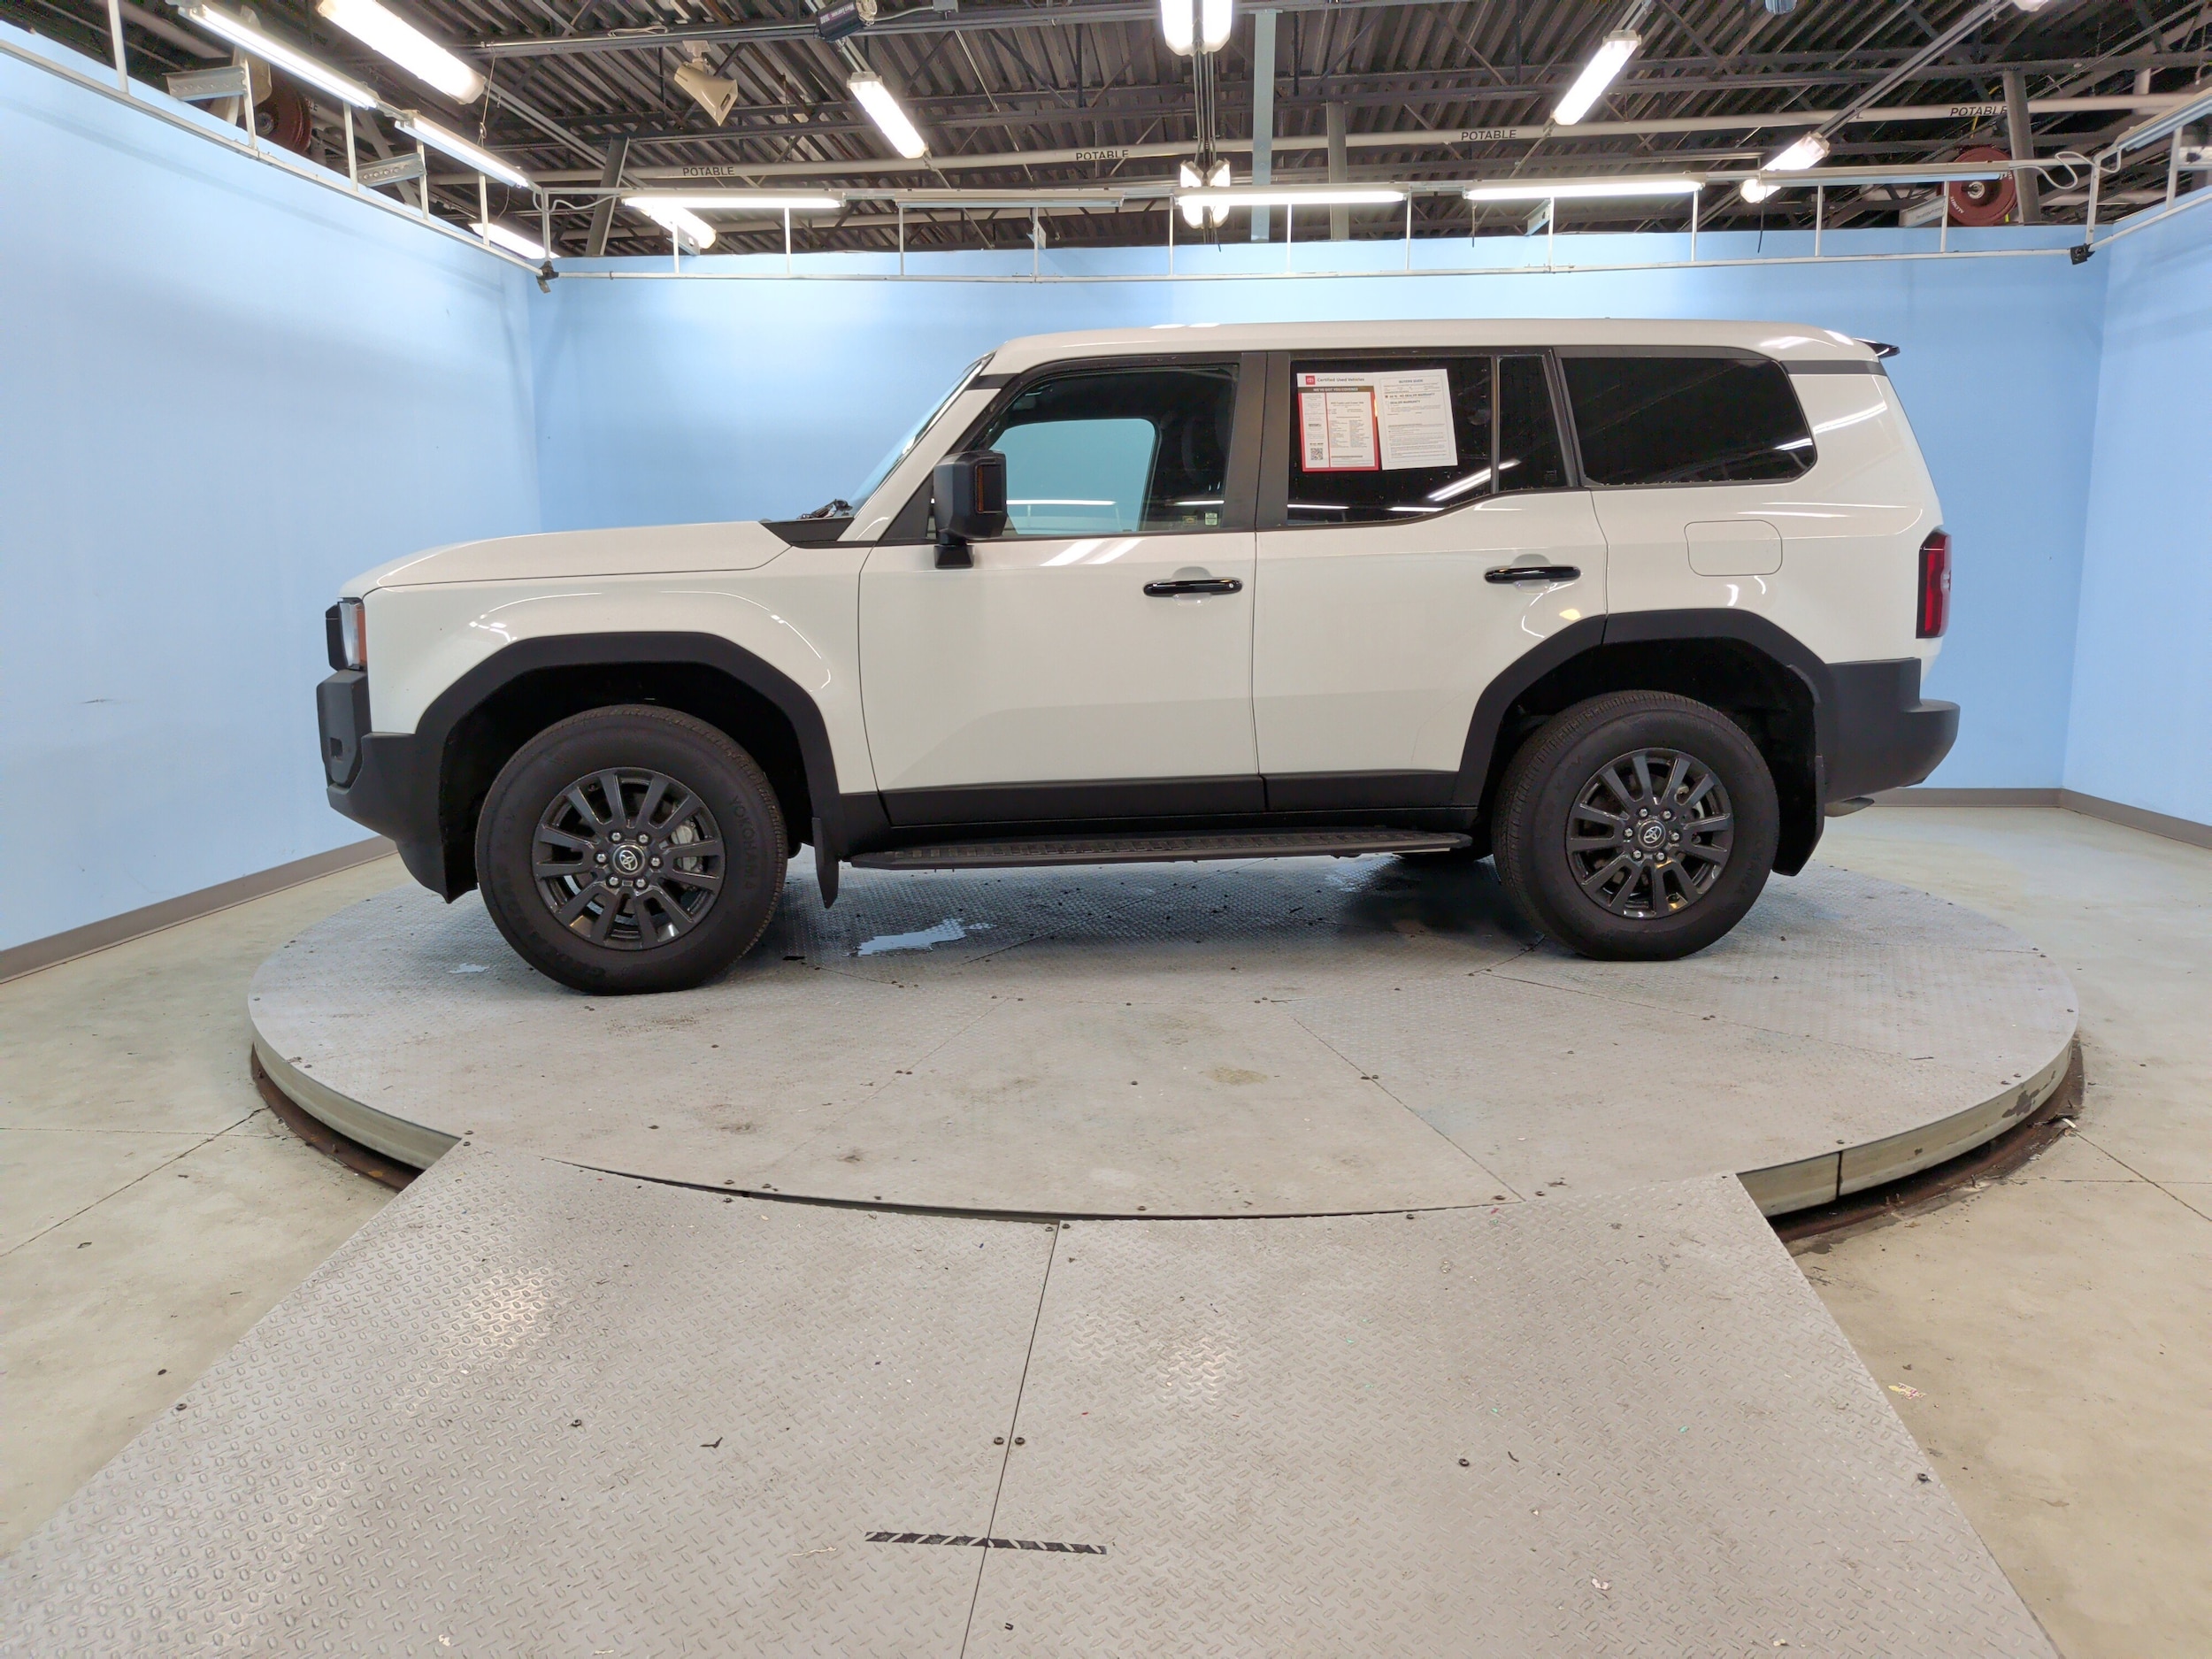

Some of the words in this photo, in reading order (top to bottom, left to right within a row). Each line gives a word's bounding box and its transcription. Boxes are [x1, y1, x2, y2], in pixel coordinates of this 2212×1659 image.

[1949, 106, 2008, 117] POTABLE
[1461, 129, 1517, 141] POTABLE
[1076, 150, 1129, 160] POTABLE
[682, 166, 735, 176] POTABLE
[728, 795, 757, 891] YOKOHAMA
